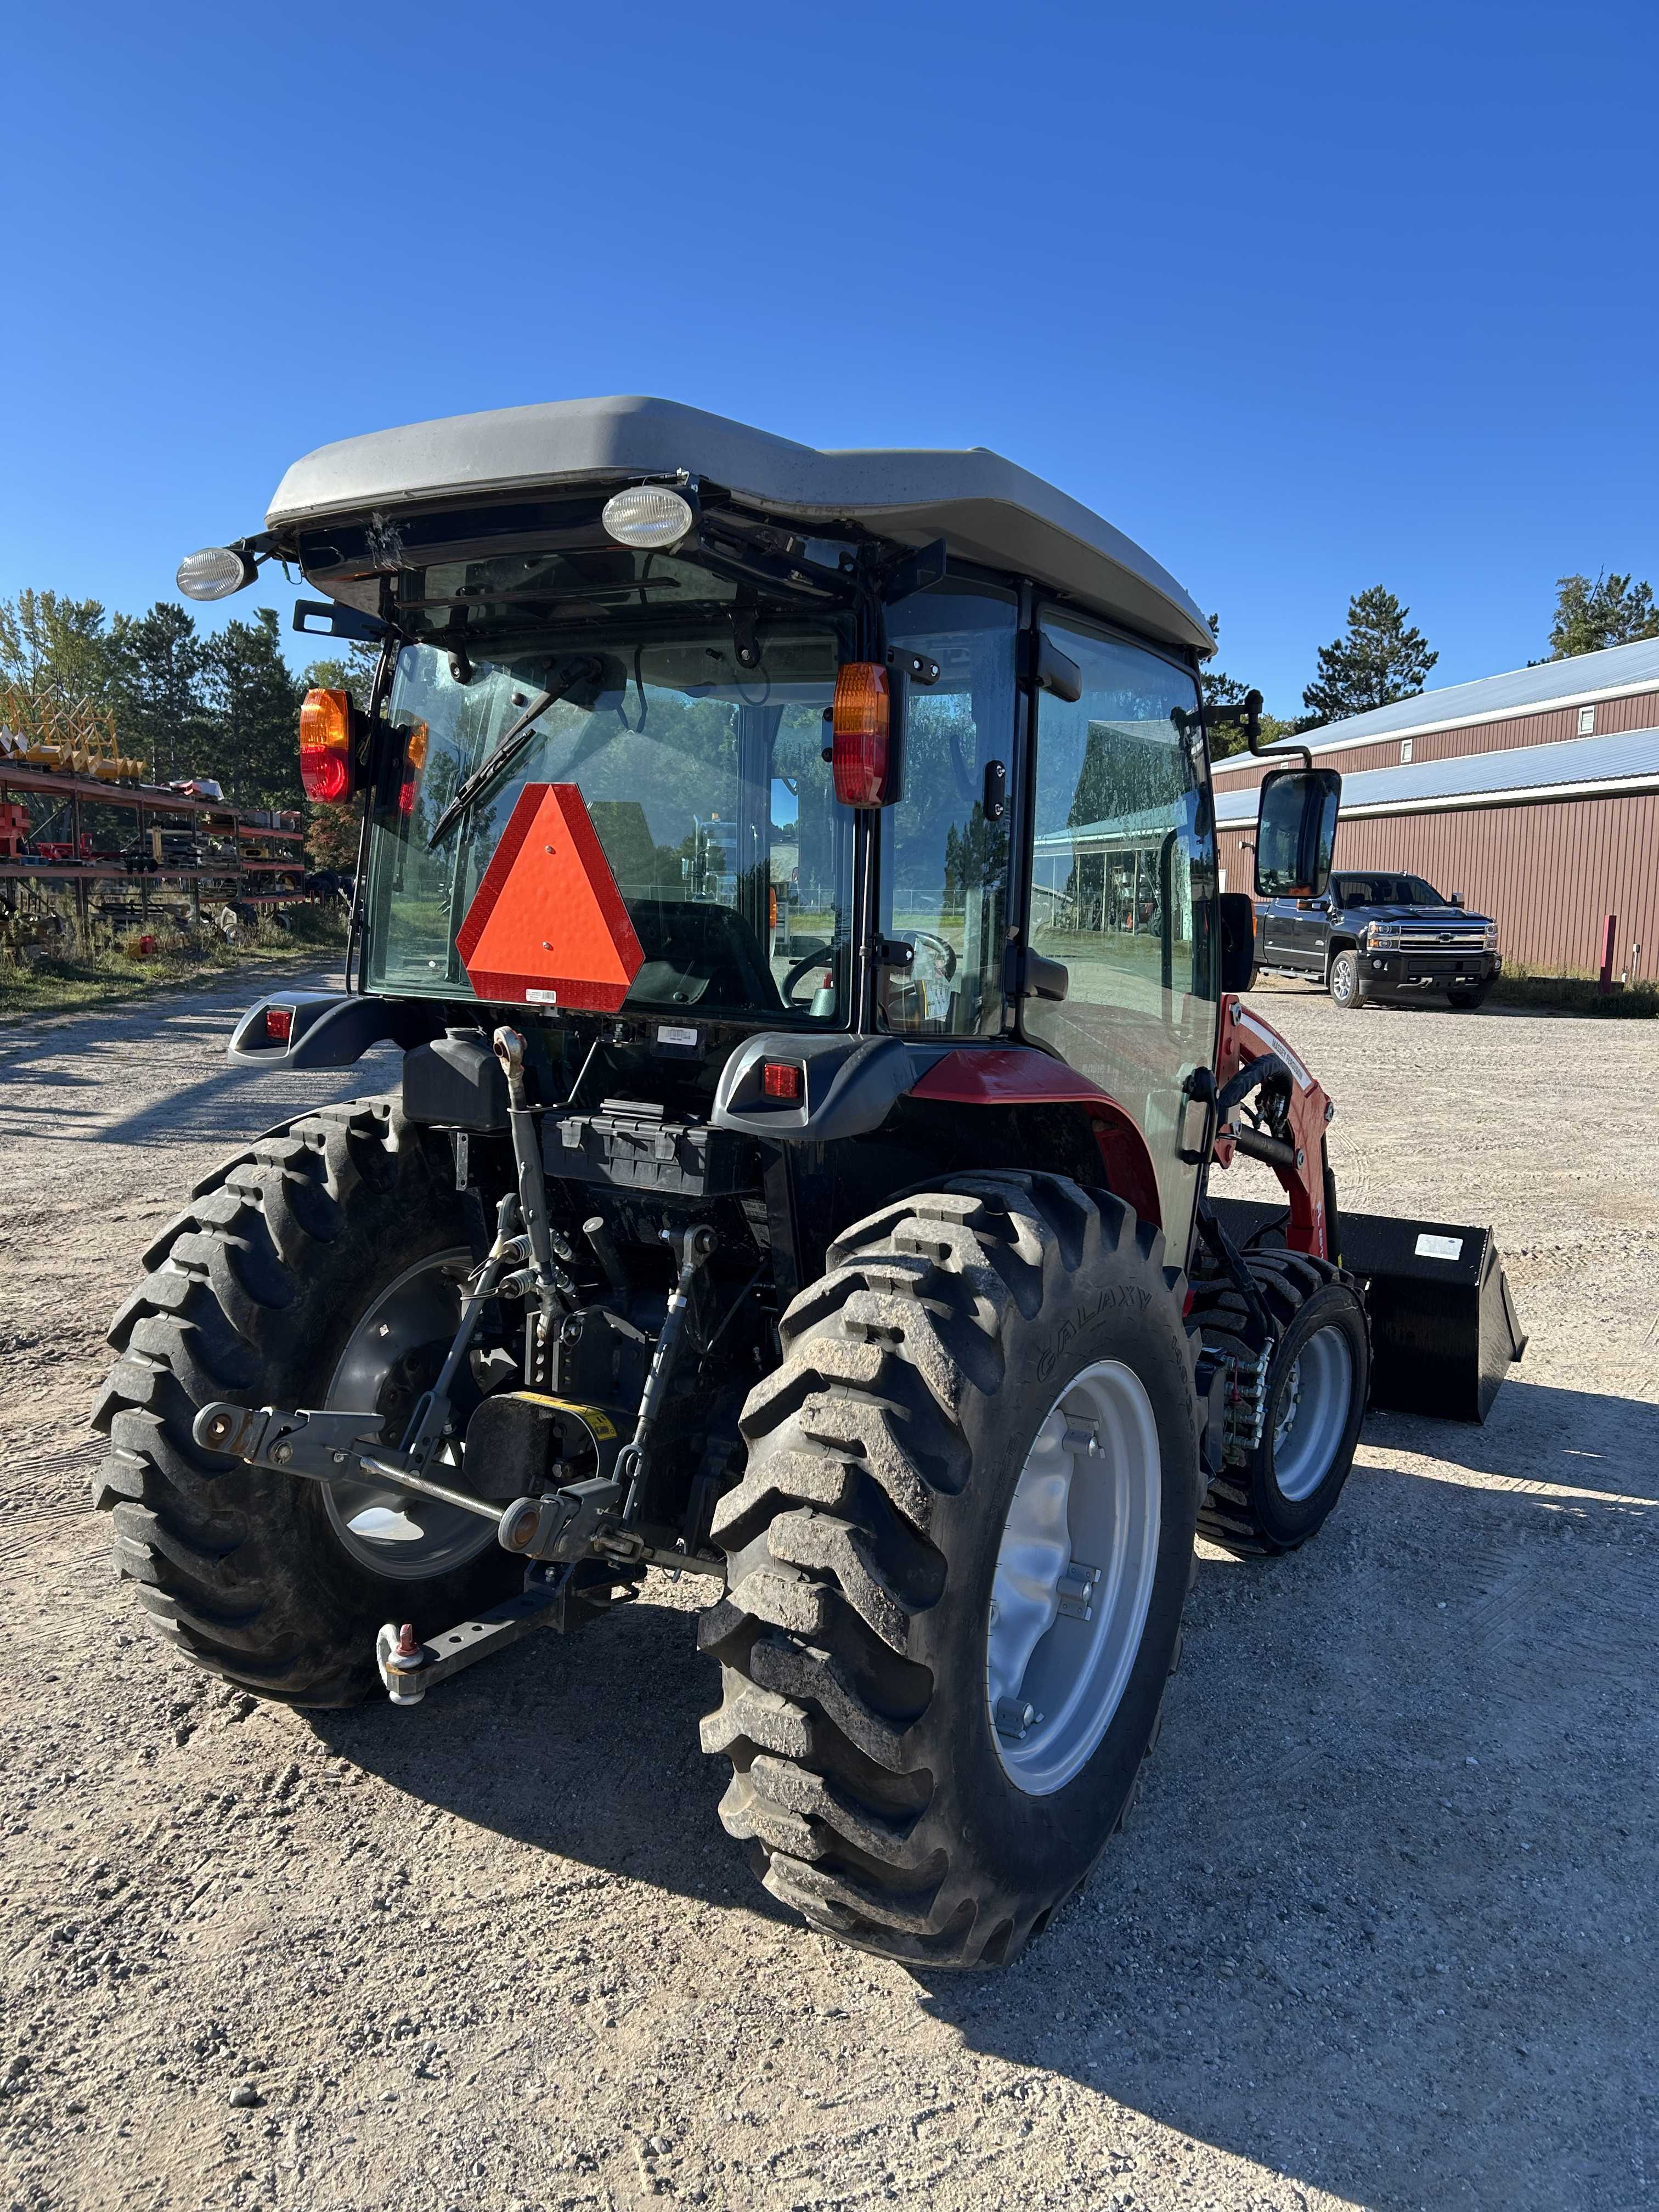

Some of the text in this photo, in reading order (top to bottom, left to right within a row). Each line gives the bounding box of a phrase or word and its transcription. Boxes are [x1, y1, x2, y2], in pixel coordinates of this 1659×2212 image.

[1272, 1038, 1303, 1081] MASSEY FERGUSON
[1037, 1285, 1152, 1383] GALAXY
